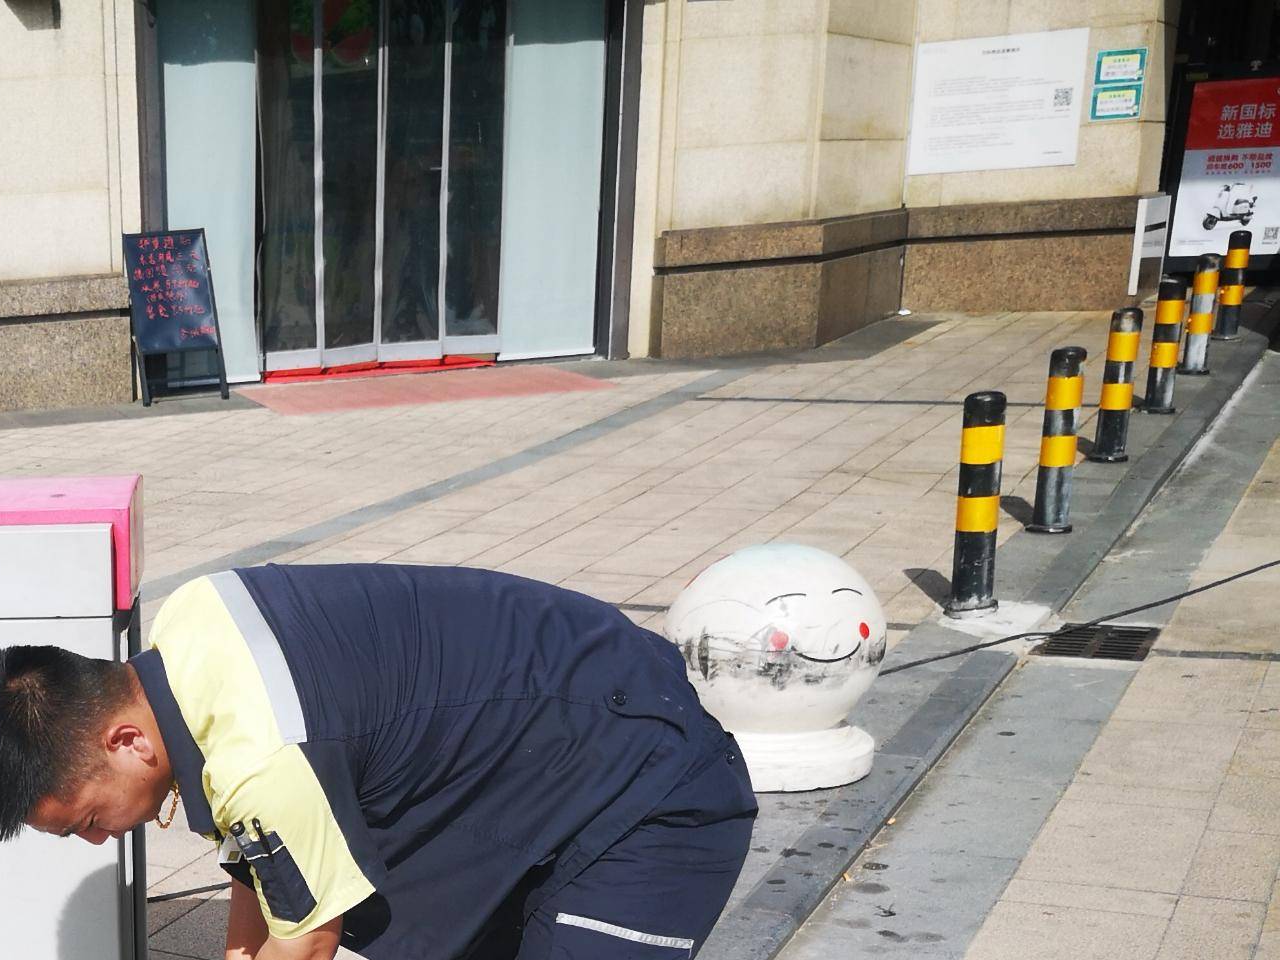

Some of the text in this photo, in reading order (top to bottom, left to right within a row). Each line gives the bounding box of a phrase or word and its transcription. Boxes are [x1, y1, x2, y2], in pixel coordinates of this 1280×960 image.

[1221, 102, 1277, 121] 新国标
[1217, 121, 1273, 140] 选雅迪
